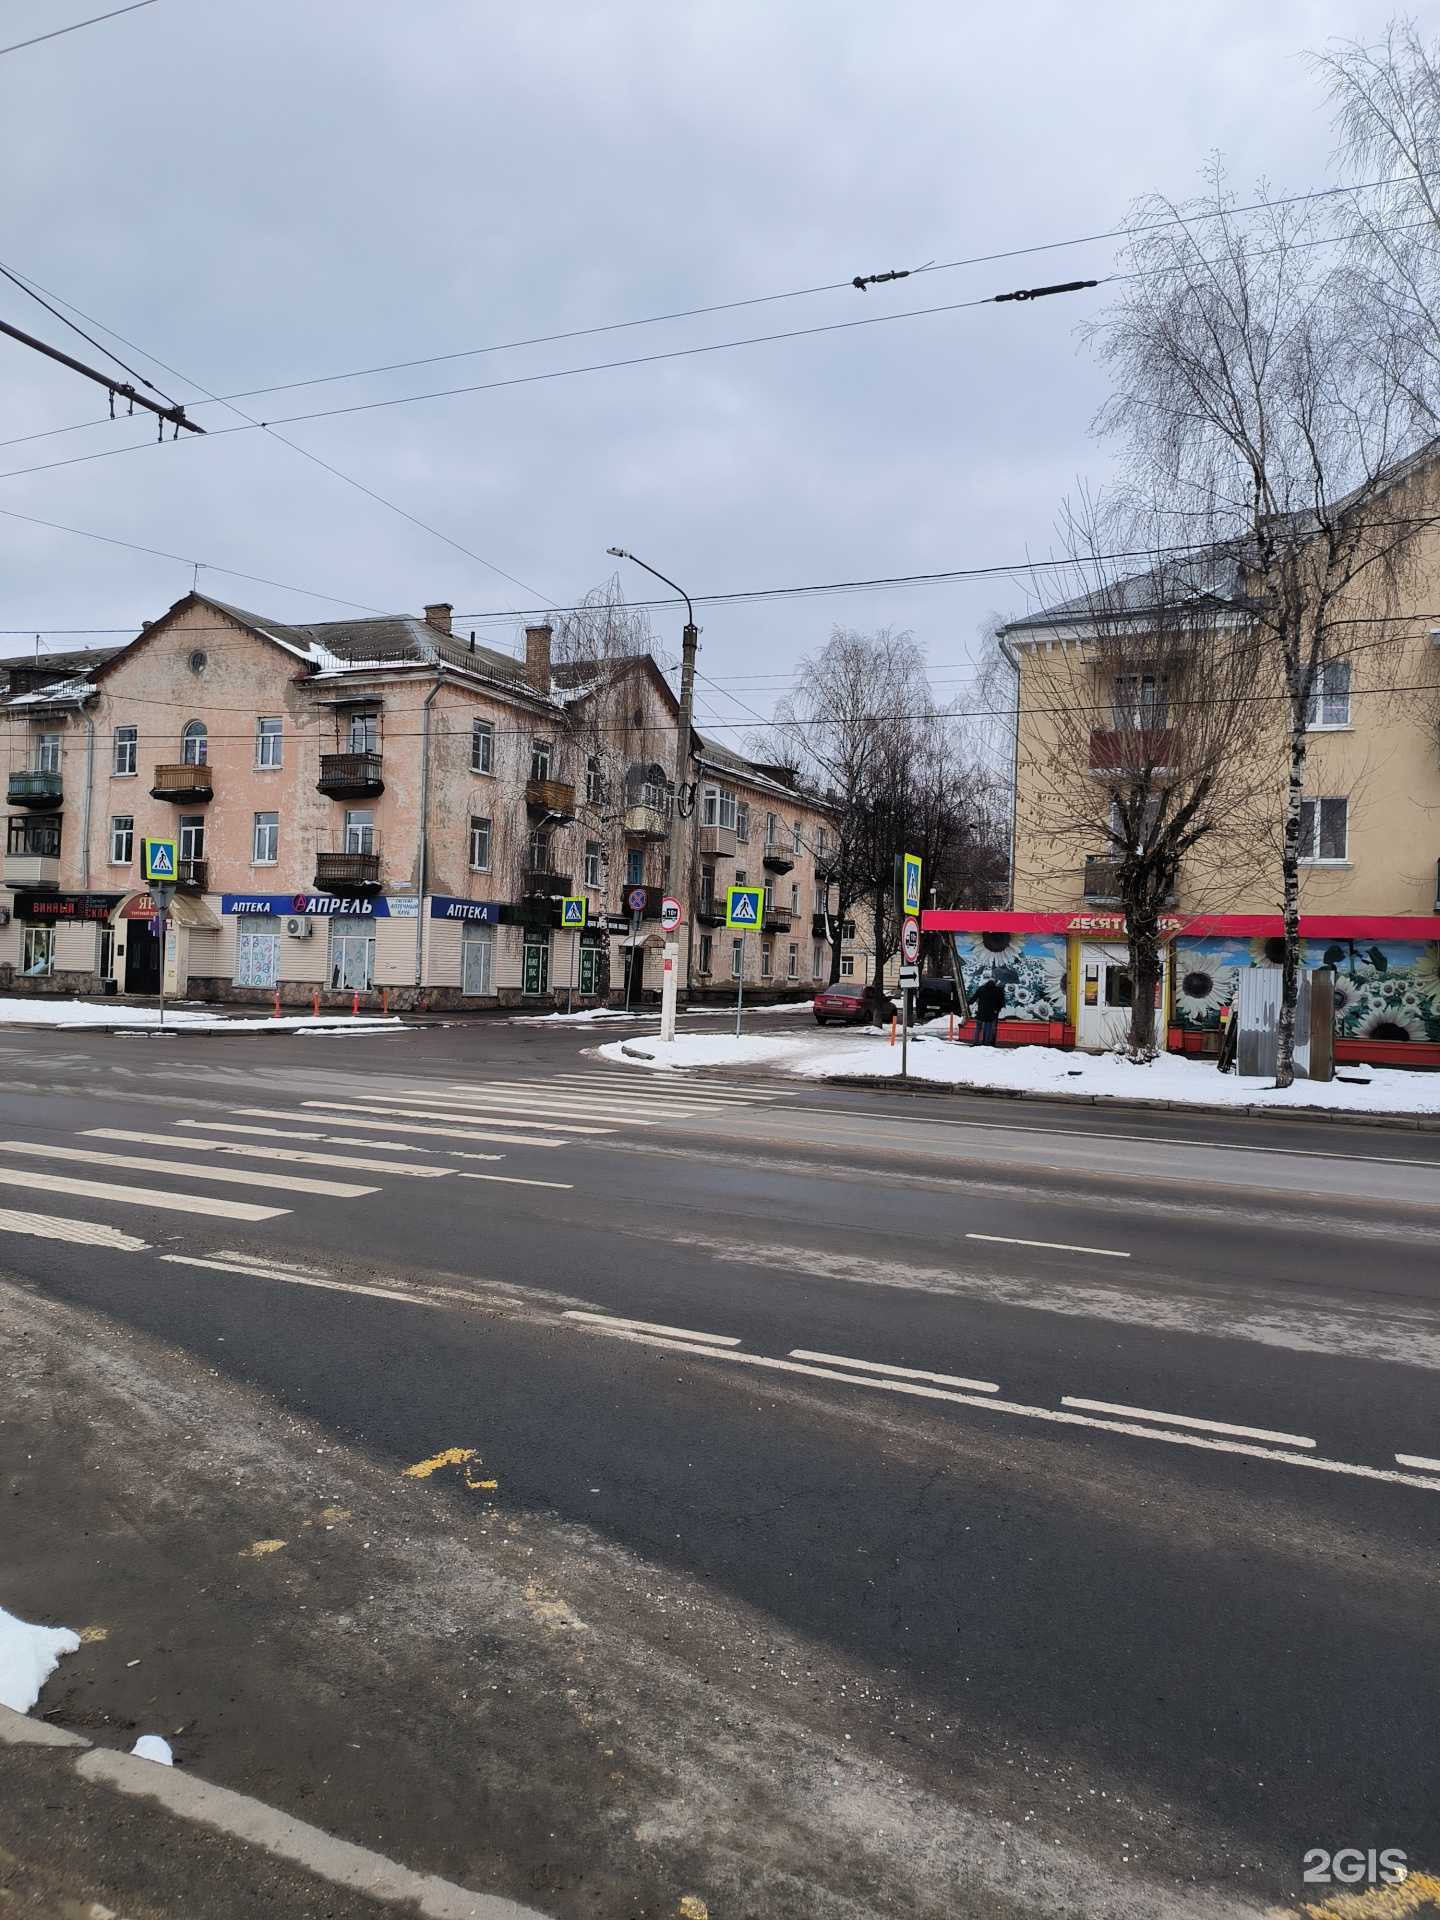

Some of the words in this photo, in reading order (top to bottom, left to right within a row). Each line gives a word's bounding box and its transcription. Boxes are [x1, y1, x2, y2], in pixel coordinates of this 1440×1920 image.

[87, 908, 113, 919] СКЛА
[231, 901, 271, 912] АПТЕКА
[305, 898, 373, 914] АПРЕЛЬ
[446, 903, 488, 920] АПТЕКА
